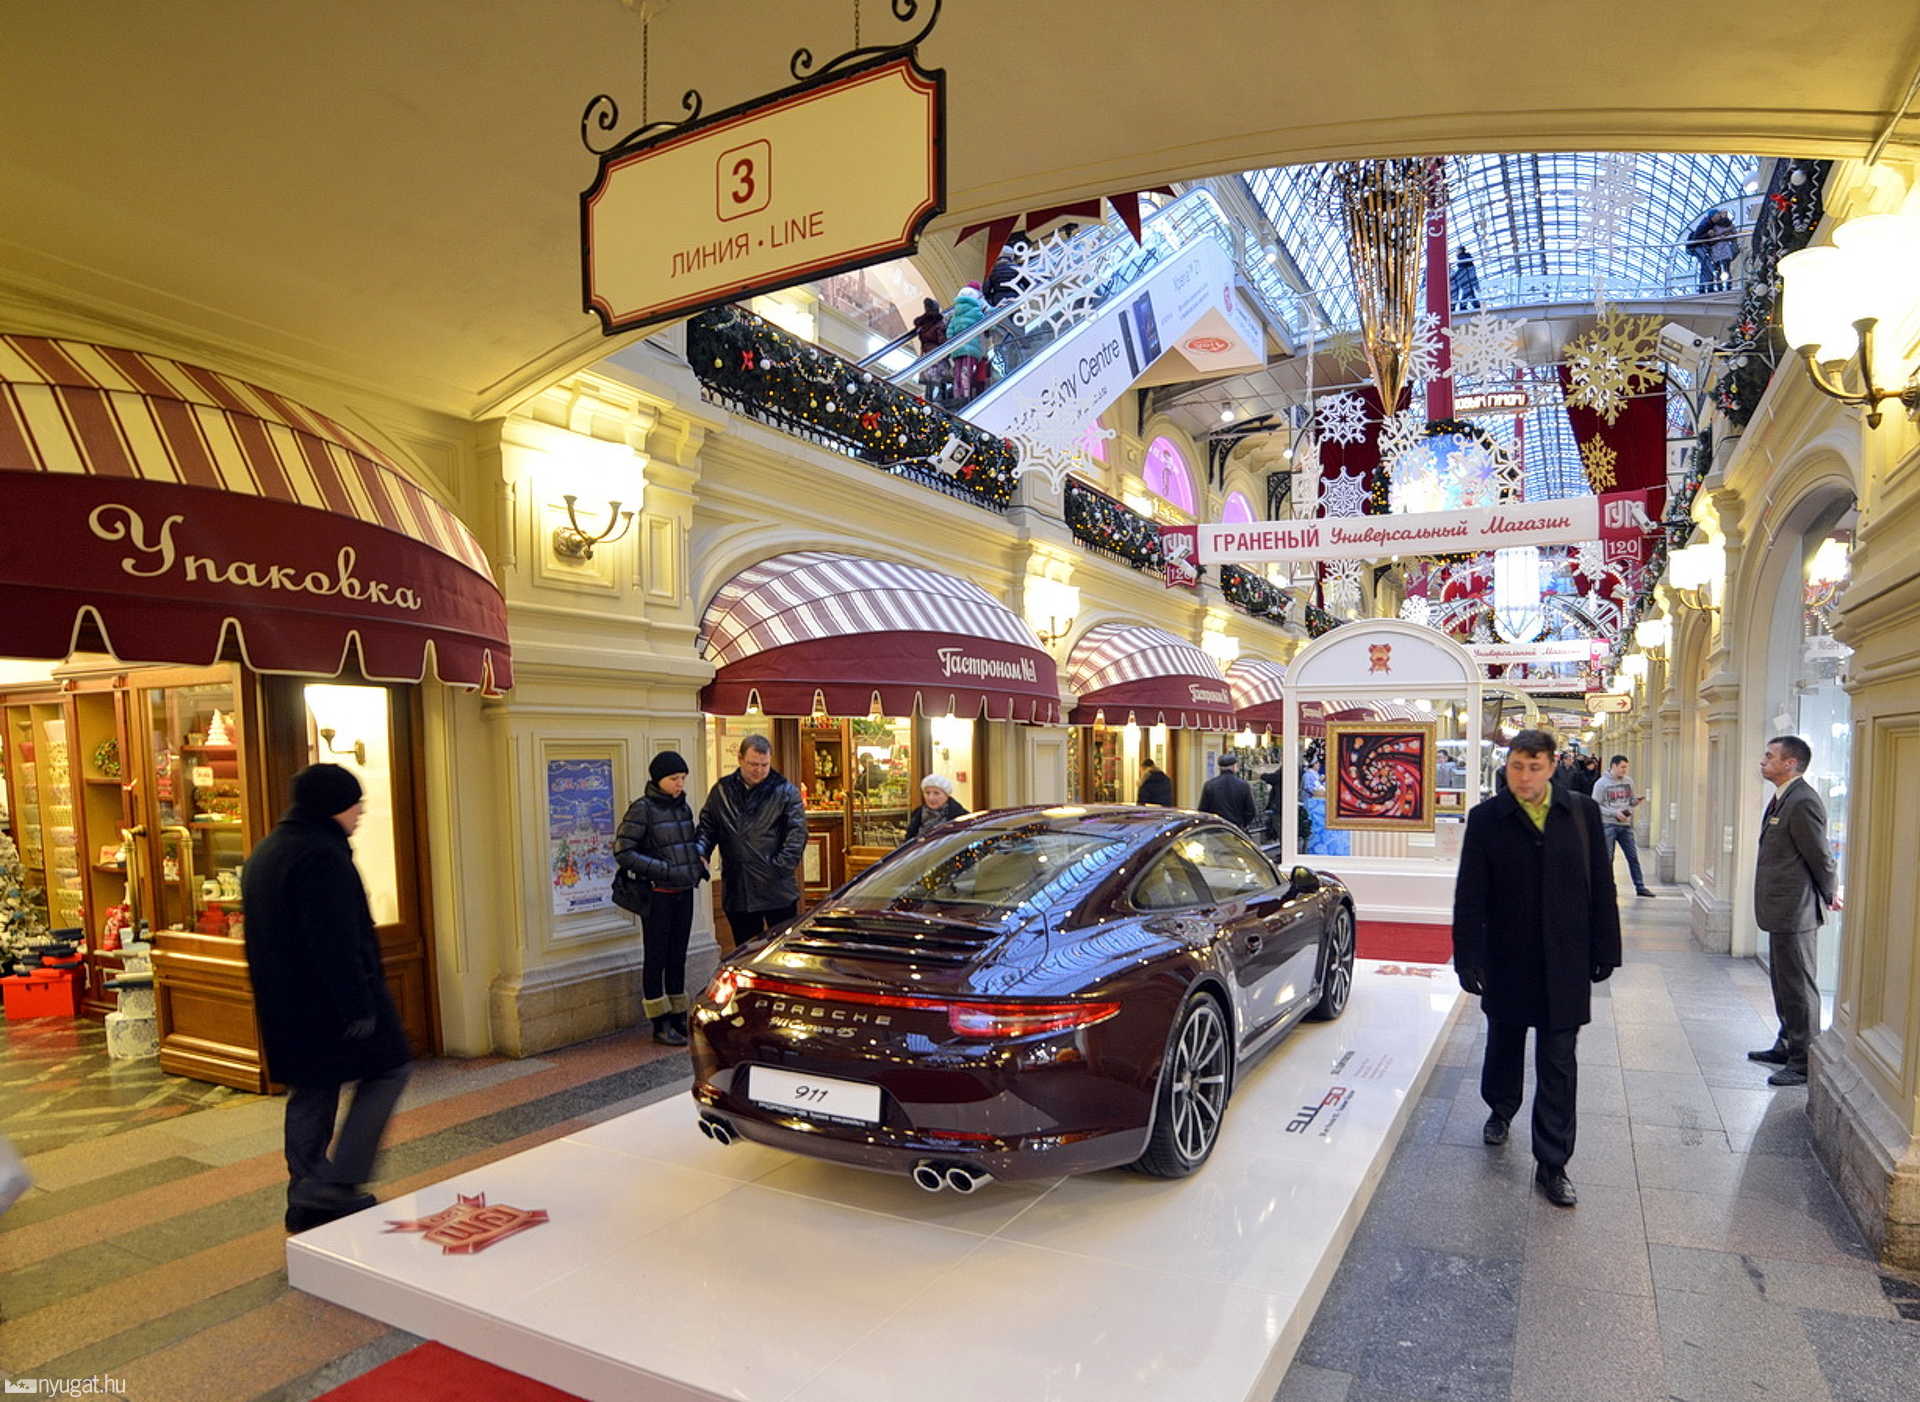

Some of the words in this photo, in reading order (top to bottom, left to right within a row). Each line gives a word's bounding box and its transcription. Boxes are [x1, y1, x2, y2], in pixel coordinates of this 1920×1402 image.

[731, 158, 755, 204] 3
[671, 233, 750, 279] ЛИНИЯ
[770, 211, 825, 249] LINE
[1078, 337, 1121, 387] Centre
[1213, 524, 1320, 552] ГРАНЕНЫЙ
[1329, 520, 1469, 547] Универсальный
[1480, 516, 1571, 535] Магазин
[1608, 539, 1638, 554] 120
[88, 503, 423, 611] Упаковка
[755, 1000, 892, 1026] PORSCHE
[795, 1085, 828, 1103] 911
